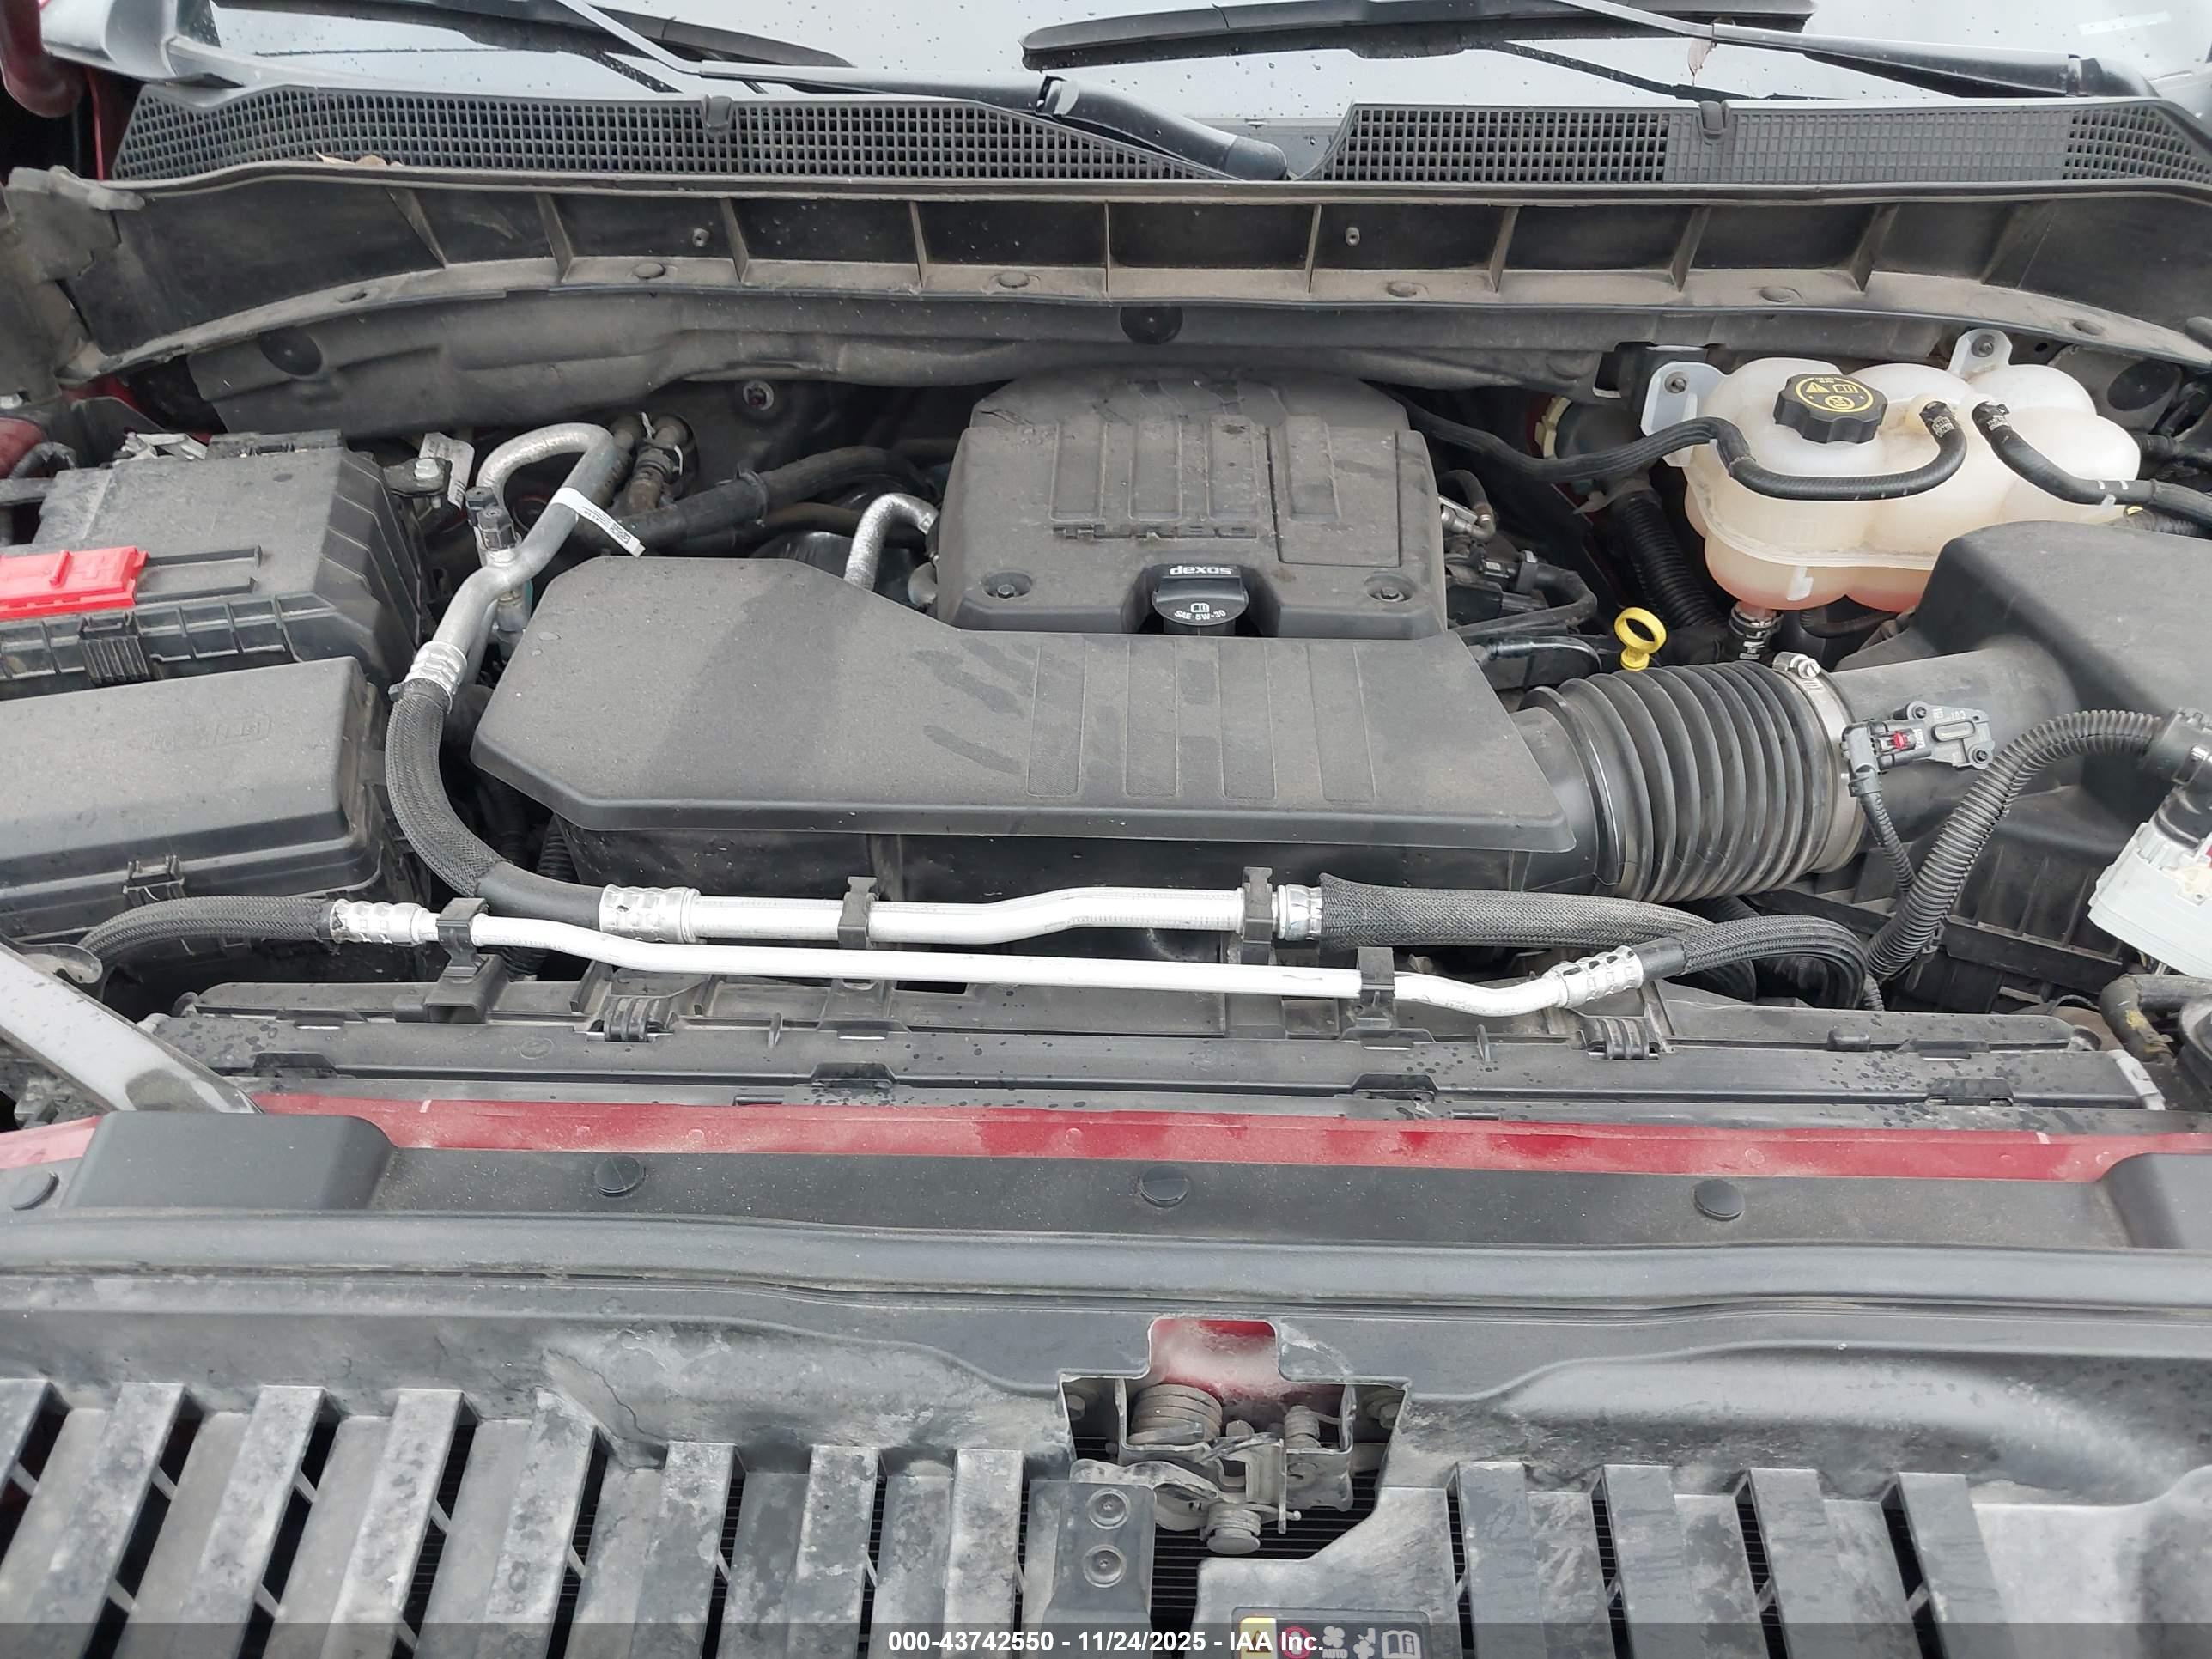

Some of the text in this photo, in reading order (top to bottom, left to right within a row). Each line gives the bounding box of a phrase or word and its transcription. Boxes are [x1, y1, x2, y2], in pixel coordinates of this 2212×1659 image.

[1169, 565, 1232, 575] dexos
[1174, 609, 1226, 620] SAE 5W-30
[1322, 1649, 1349, 1659] AUTO
